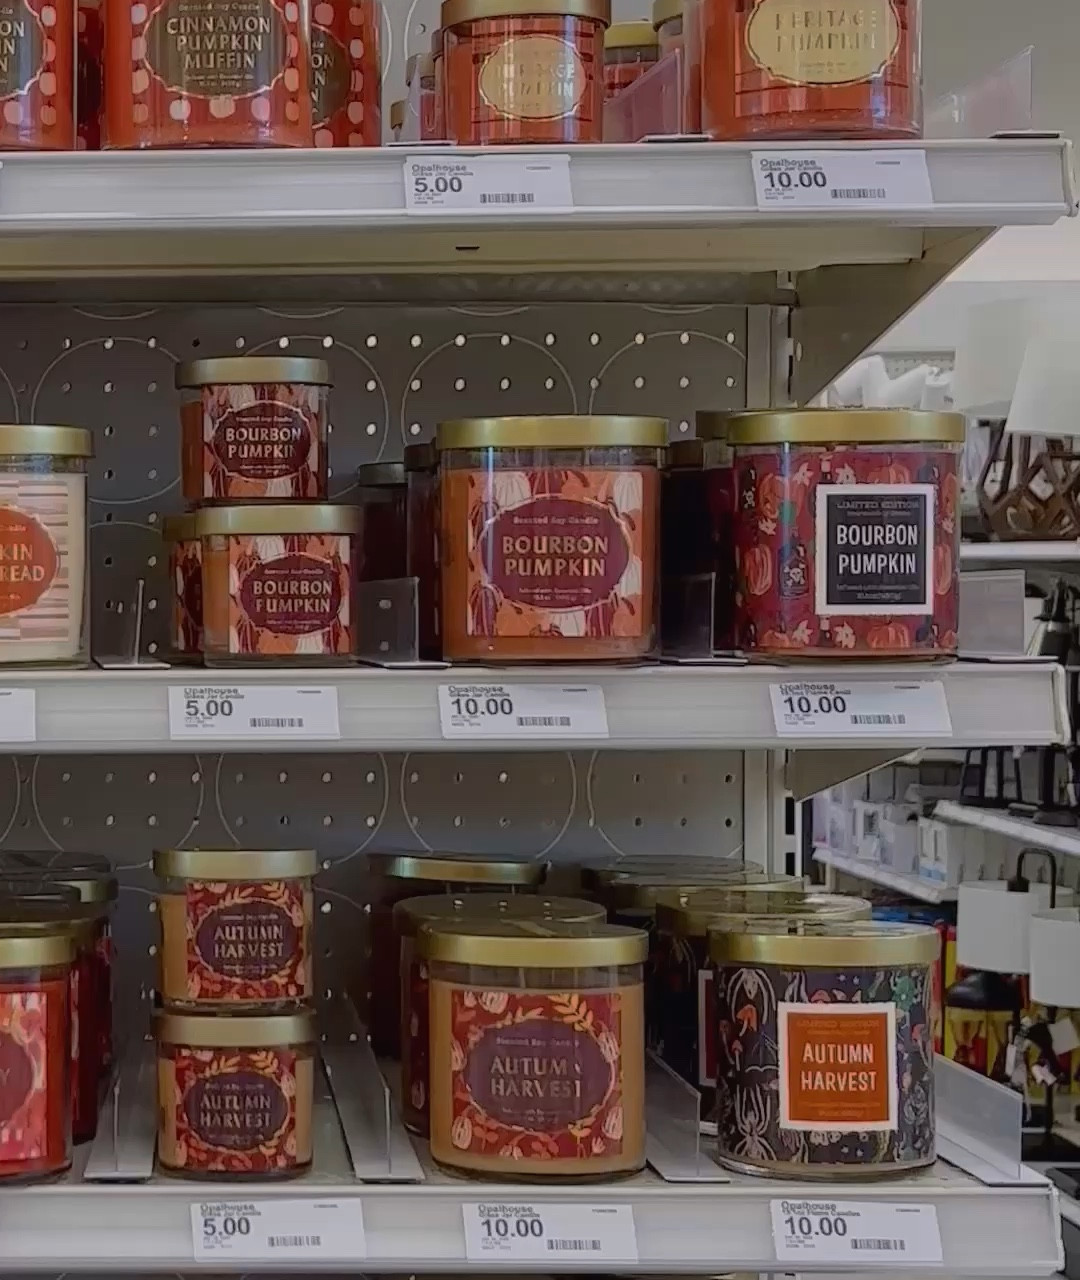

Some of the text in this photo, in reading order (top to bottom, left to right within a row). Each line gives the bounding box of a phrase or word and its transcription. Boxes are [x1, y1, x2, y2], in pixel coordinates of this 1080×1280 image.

[166, 15, 271, 36] CINNAMON
[175, 34, 263, 53] PUMPKIN
[183, 52, 257, 70] MUFFIN
[414, 177, 463, 193] 5.00
[764, 172, 827, 188] 10.00
[225, 426, 302, 442] BOURBON
[228, 443, 297, 460] PUMPKIN
[836, 523, 918, 546] BOURBON
[502, 535, 609, 554] BOURBON
[504, 557, 606, 577] PUMPKIN
[839, 553, 917, 576] PUMPKIN
[252, 580, 333, 596] BOURBON
[255, 597, 331, 614] PUMPKIN
[185, 700, 233, 717] 5.00
[451, 698, 514, 715] 10.00
[784, 696, 847, 713] 10.00
[214, 924, 284, 940] AUTUMN
[213, 941, 284, 958] HARVEST
[802, 1042, 874, 1065] AUTUMN
[490, 1078, 582, 1098] HARVEST
[800, 1070, 877, 1092] HARVEST
[199, 1094, 272, 1110] AUTUMN
[199, 1111, 272, 1128] HARVEST
[203, 1217, 251, 1236] 5.00
[480, 1218, 544, 1237] 10.00
[784, 1216, 848, 1236] 10.00
